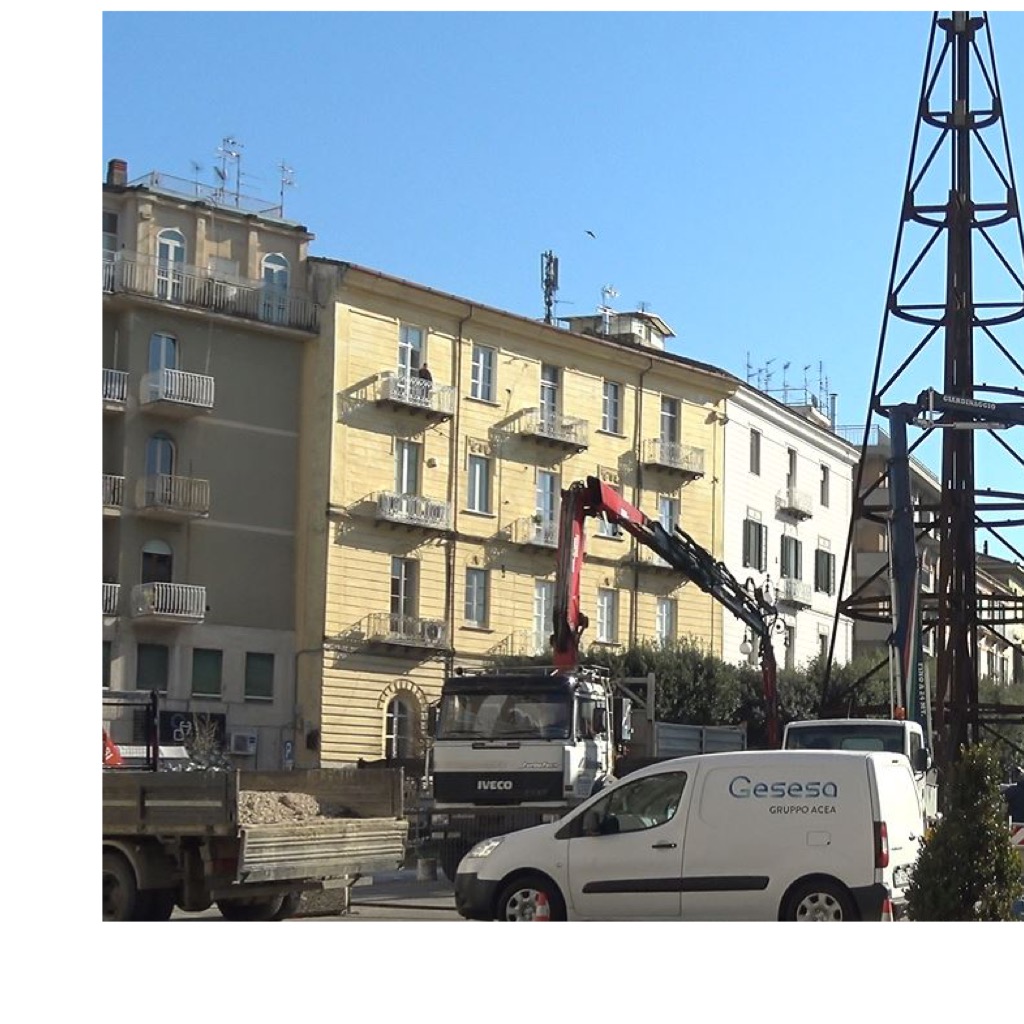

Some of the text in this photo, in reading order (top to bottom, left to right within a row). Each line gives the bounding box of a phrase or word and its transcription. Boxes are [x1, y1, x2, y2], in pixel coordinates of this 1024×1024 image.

[477, 780, 513, 790] IVECO
[728, 775, 838, 799] Gesesa
[769, 805, 837, 814] GRUPPO ACEA
